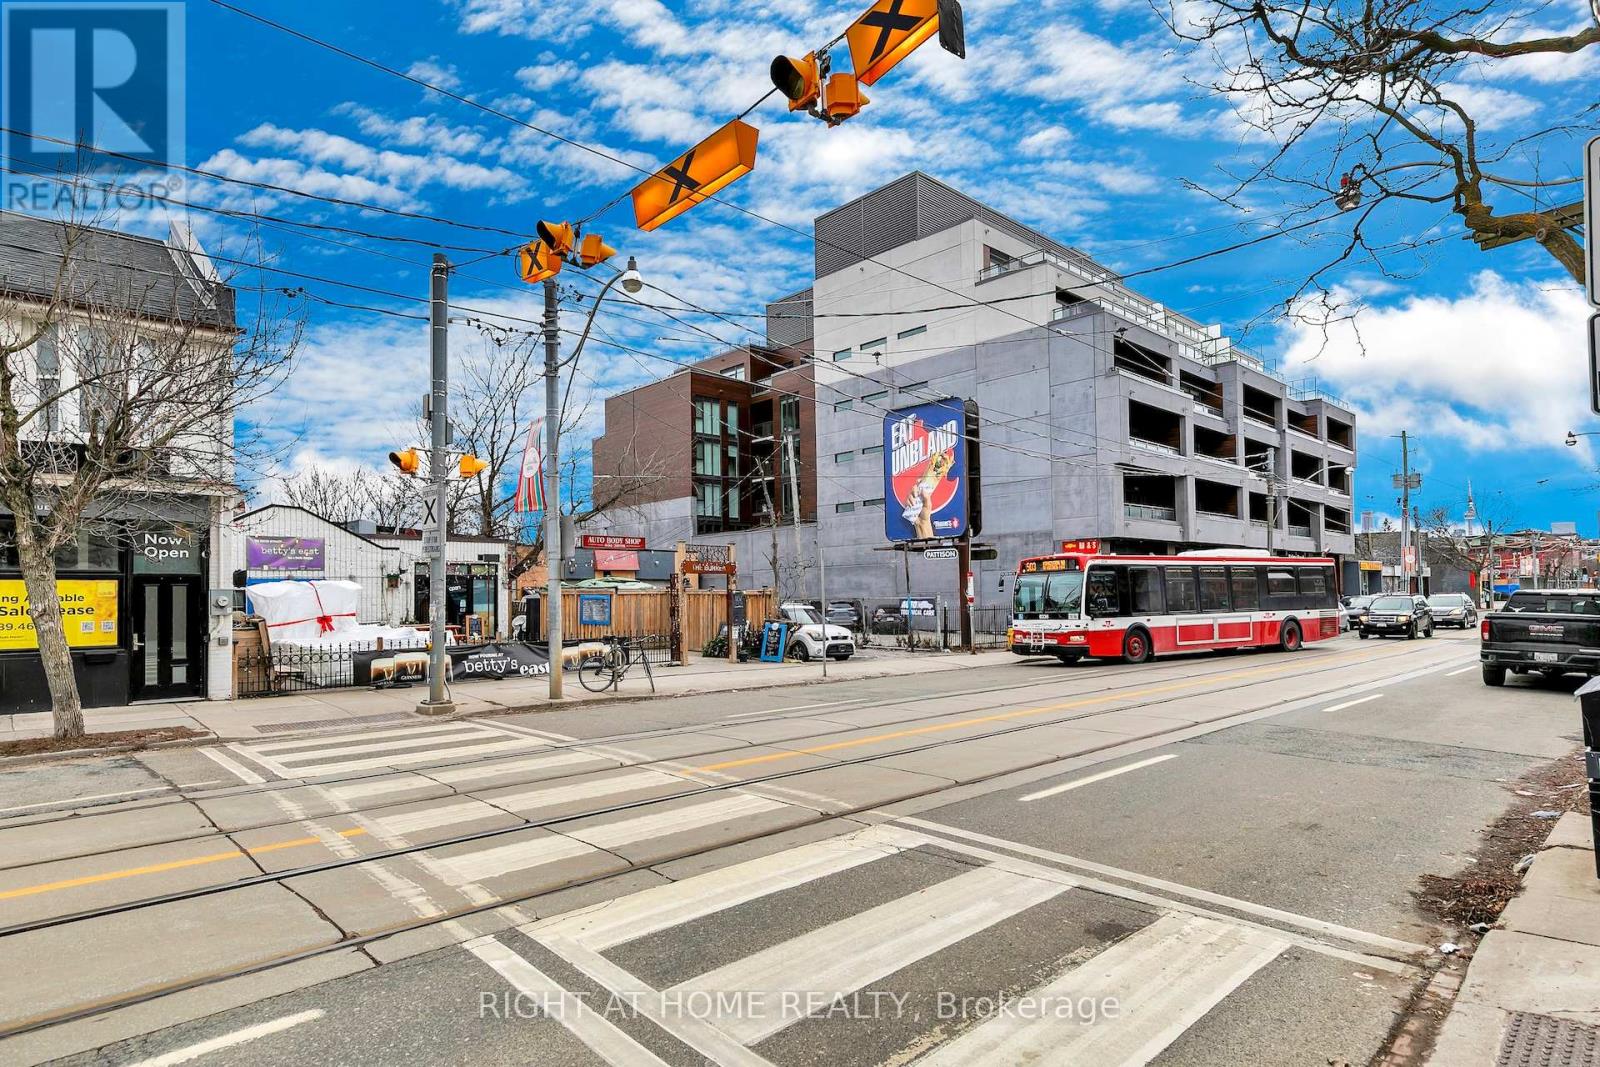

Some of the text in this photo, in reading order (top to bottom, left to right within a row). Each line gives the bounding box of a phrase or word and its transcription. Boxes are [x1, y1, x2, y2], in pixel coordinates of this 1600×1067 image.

[892, 413, 917, 450] EAT
[892, 420, 959, 476] UNBLAND
[144, 533, 182, 545] Now
[588, 536, 605, 544] AUTO
[144, 546, 189, 560] Open
[261, 546, 296, 556] betty's
[926, 550, 956, 558] PATTISON
[1026, 562, 1037, 572] 503
[462, 656, 550, 676] betty's east
